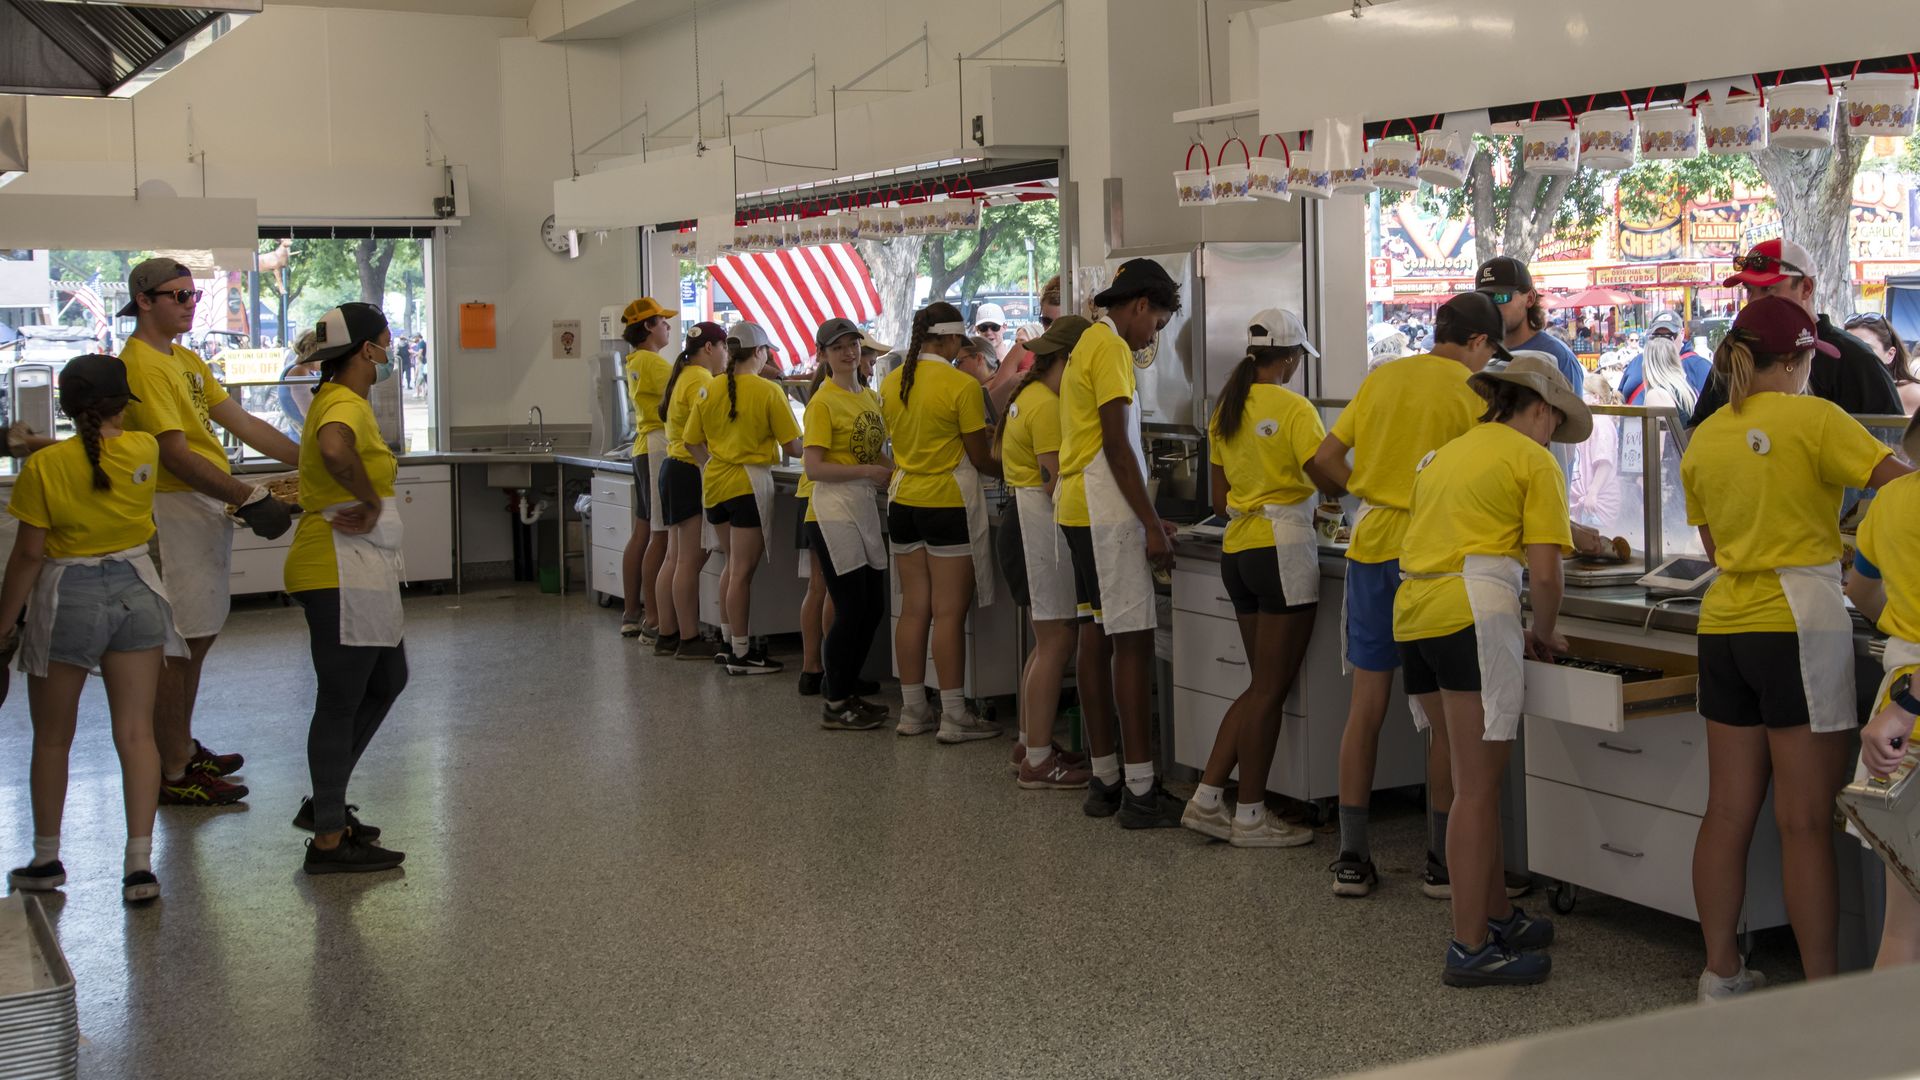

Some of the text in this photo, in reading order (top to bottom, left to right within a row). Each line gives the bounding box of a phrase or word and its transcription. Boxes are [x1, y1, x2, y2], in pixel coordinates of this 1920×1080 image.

[1697, 225, 1735, 238] CAJUN
[1860, 225, 1899, 238] GARLIC
[1620, 223, 1681, 258] CHEESE
[1403, 258, 1435, 270] CORN
[1600, 274, 1654, 283] CHEESE CURDS
[260, 362, 279, 374] OFF
